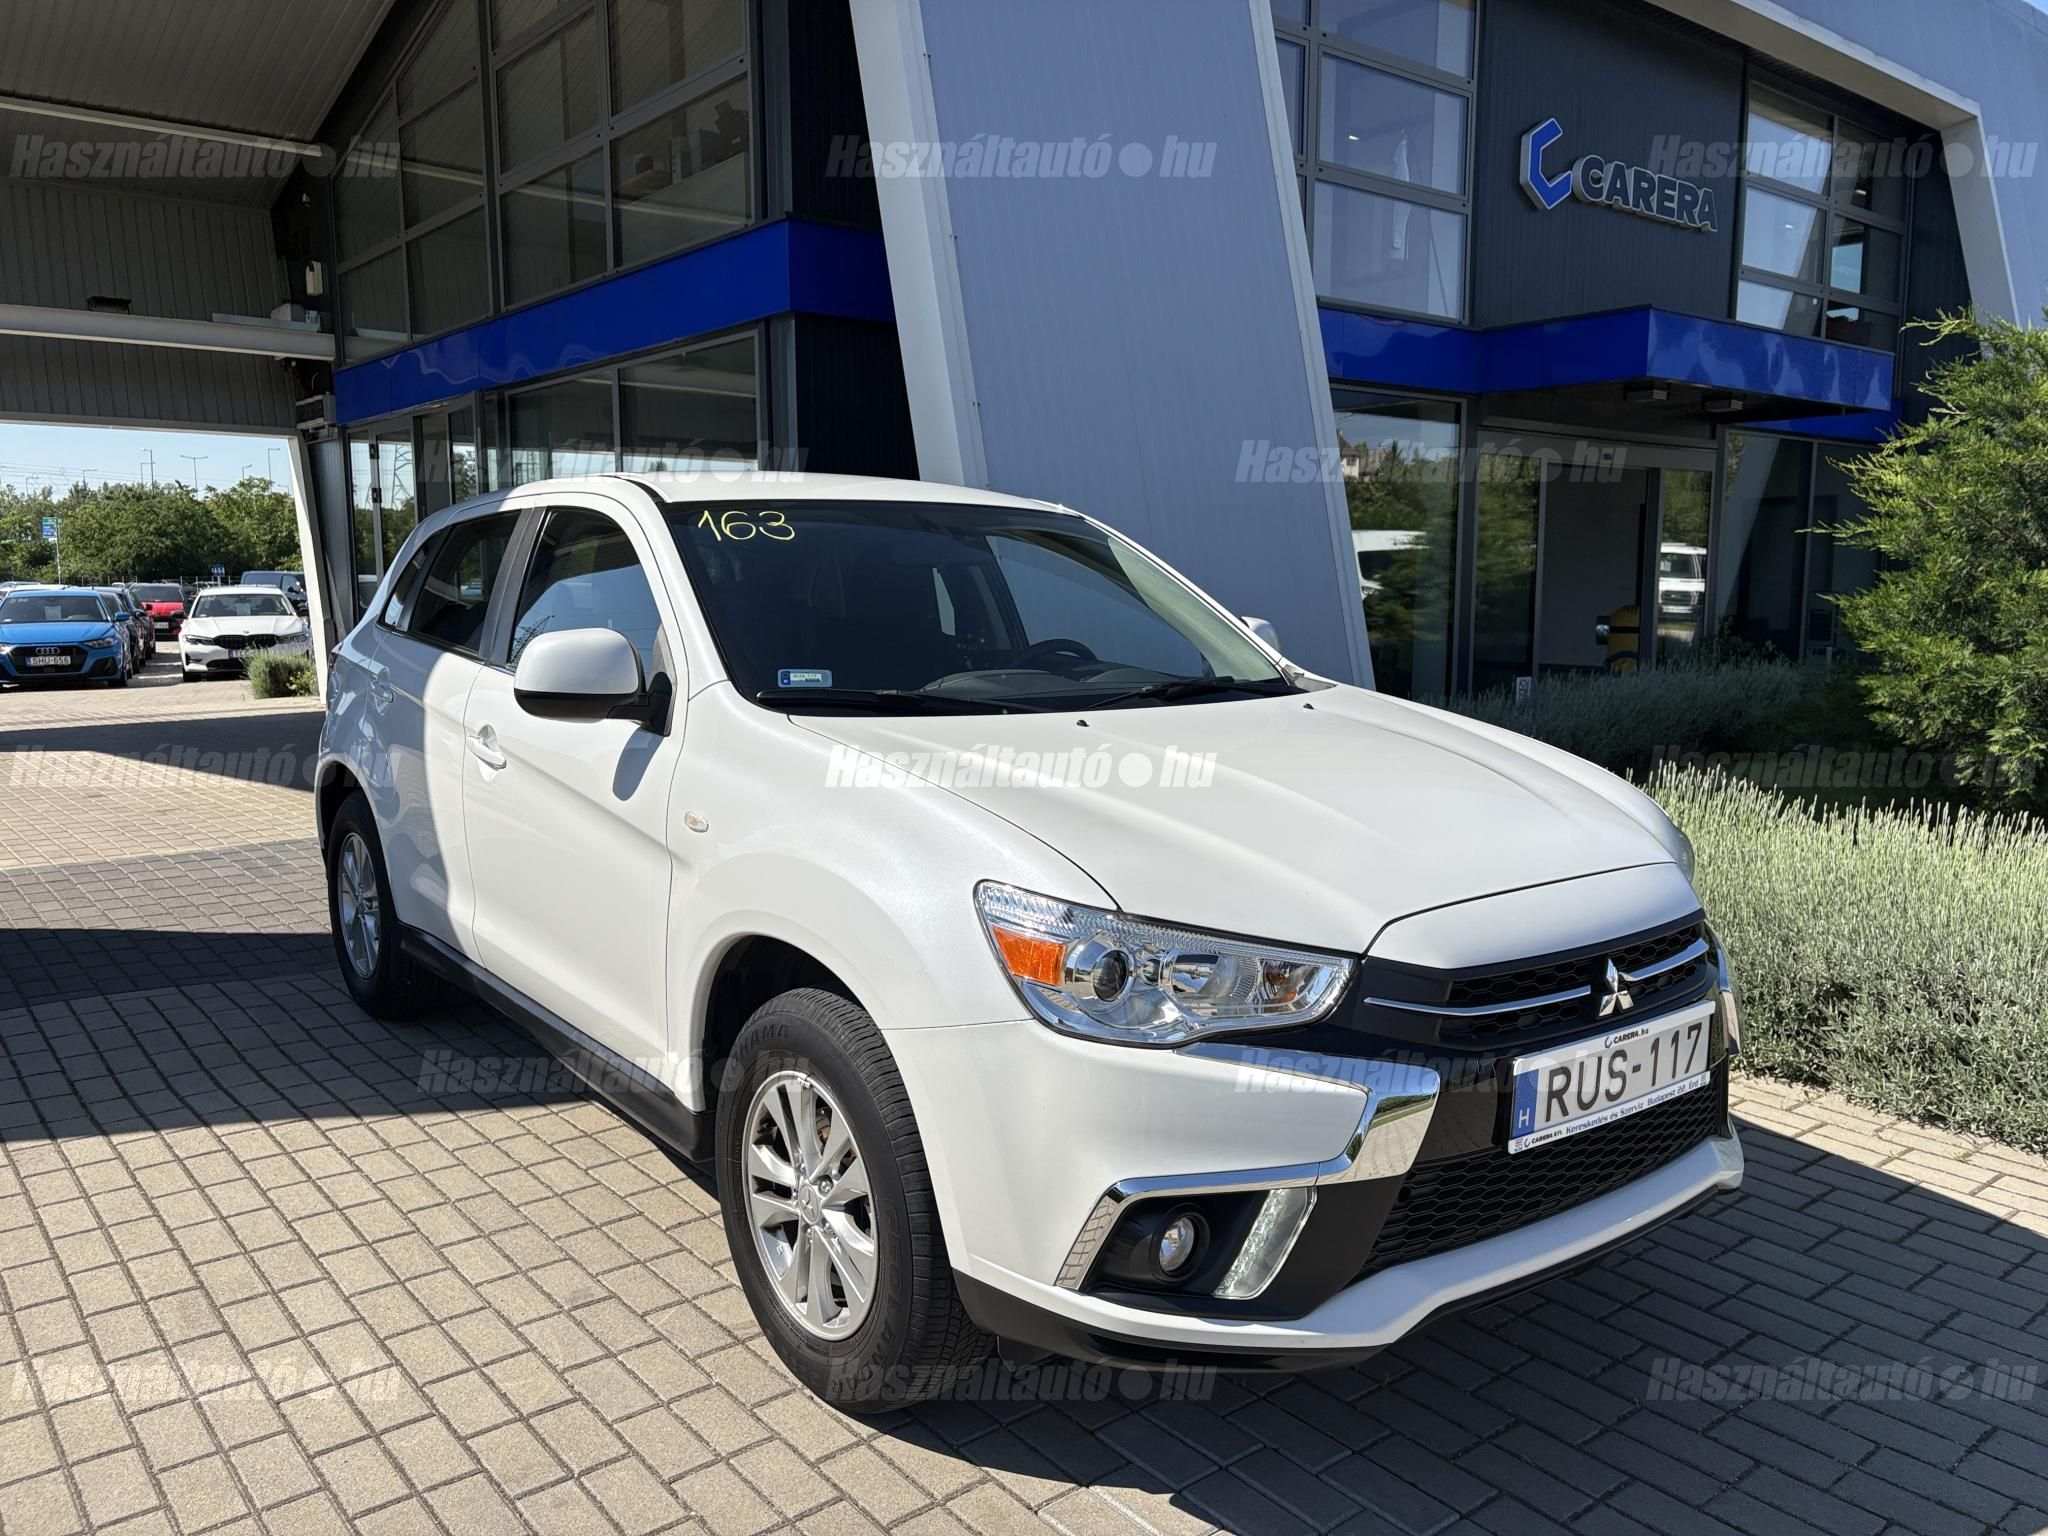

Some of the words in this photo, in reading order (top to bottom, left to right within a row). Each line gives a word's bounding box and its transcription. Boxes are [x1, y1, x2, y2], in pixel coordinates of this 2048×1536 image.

[1572, 154, 1718, 232] CARERA
[697, 510, 795, 541] 163
[1545, 1022, 1703, 1123] RUS-117
[1518, 1107, 1530, 1129] H
